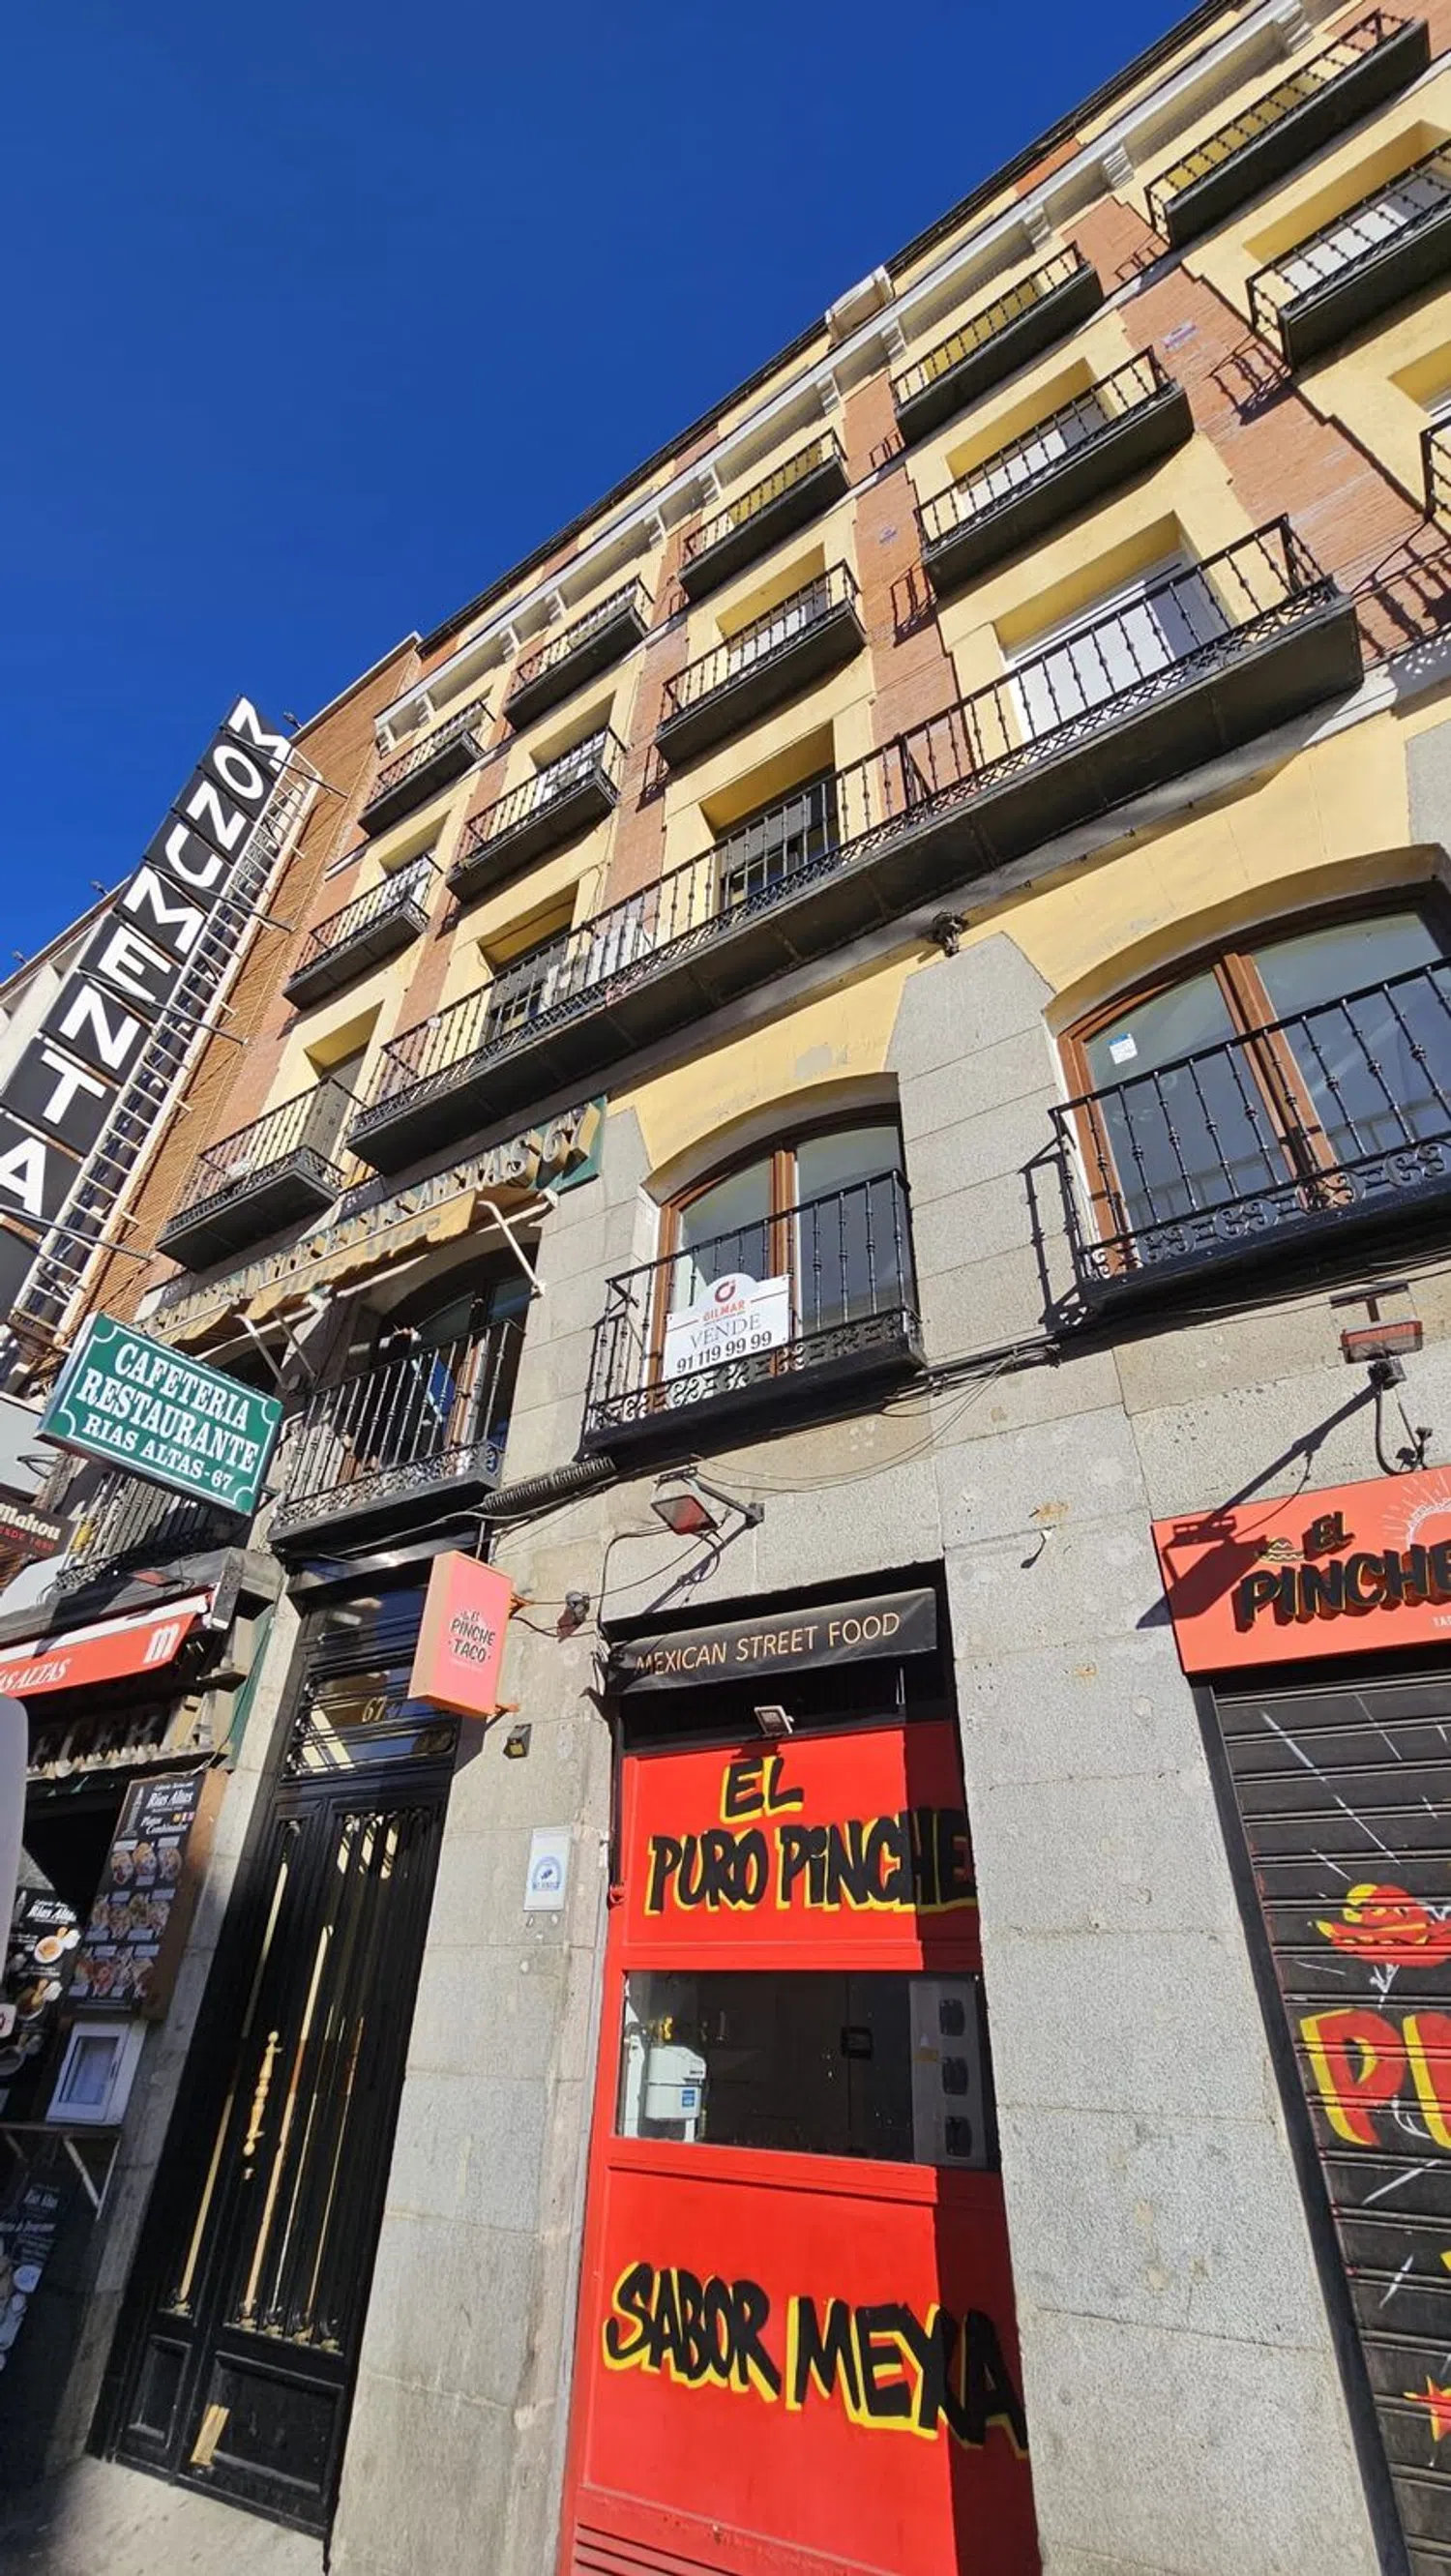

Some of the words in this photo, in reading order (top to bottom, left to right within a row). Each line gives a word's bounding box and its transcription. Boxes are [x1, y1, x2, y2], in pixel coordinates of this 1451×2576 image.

[690, 1313, 761, 1349] VENDE
[703, 1300, 745, 1322] GILMAR
[677, 1355, 694, 1374] 91
[698, 1346, 721, 1367] 119
[726, 1337, 747, 1353] 99
[751, 1330, 773, 1347] 99
[114, 1342, 250, 1432] CAFETERIA
[75, 1369, 259, 1475] RESTAURANTE
[82, 1412, 137, 1452] RIAS
[1303, 1511, 1355, 1560] EL
[1231, 1539, 1451, 1633] PINCHE
[451, 1618, 495, 1646] PINCHE
[454, 1638, 487, 1663] TACO
[635, 1642, 726, 1677] MEXICAN
[735, 1625, 817, 1663] STREET
[828, 1611, 902, 1646] FOOD
[362, 1696, 388, 1722] 67
[720, 1755, 804, 1824] EL
[644, 1826, 769, 1916] PURO
[603, 2261, 782, 2404] SABOR
